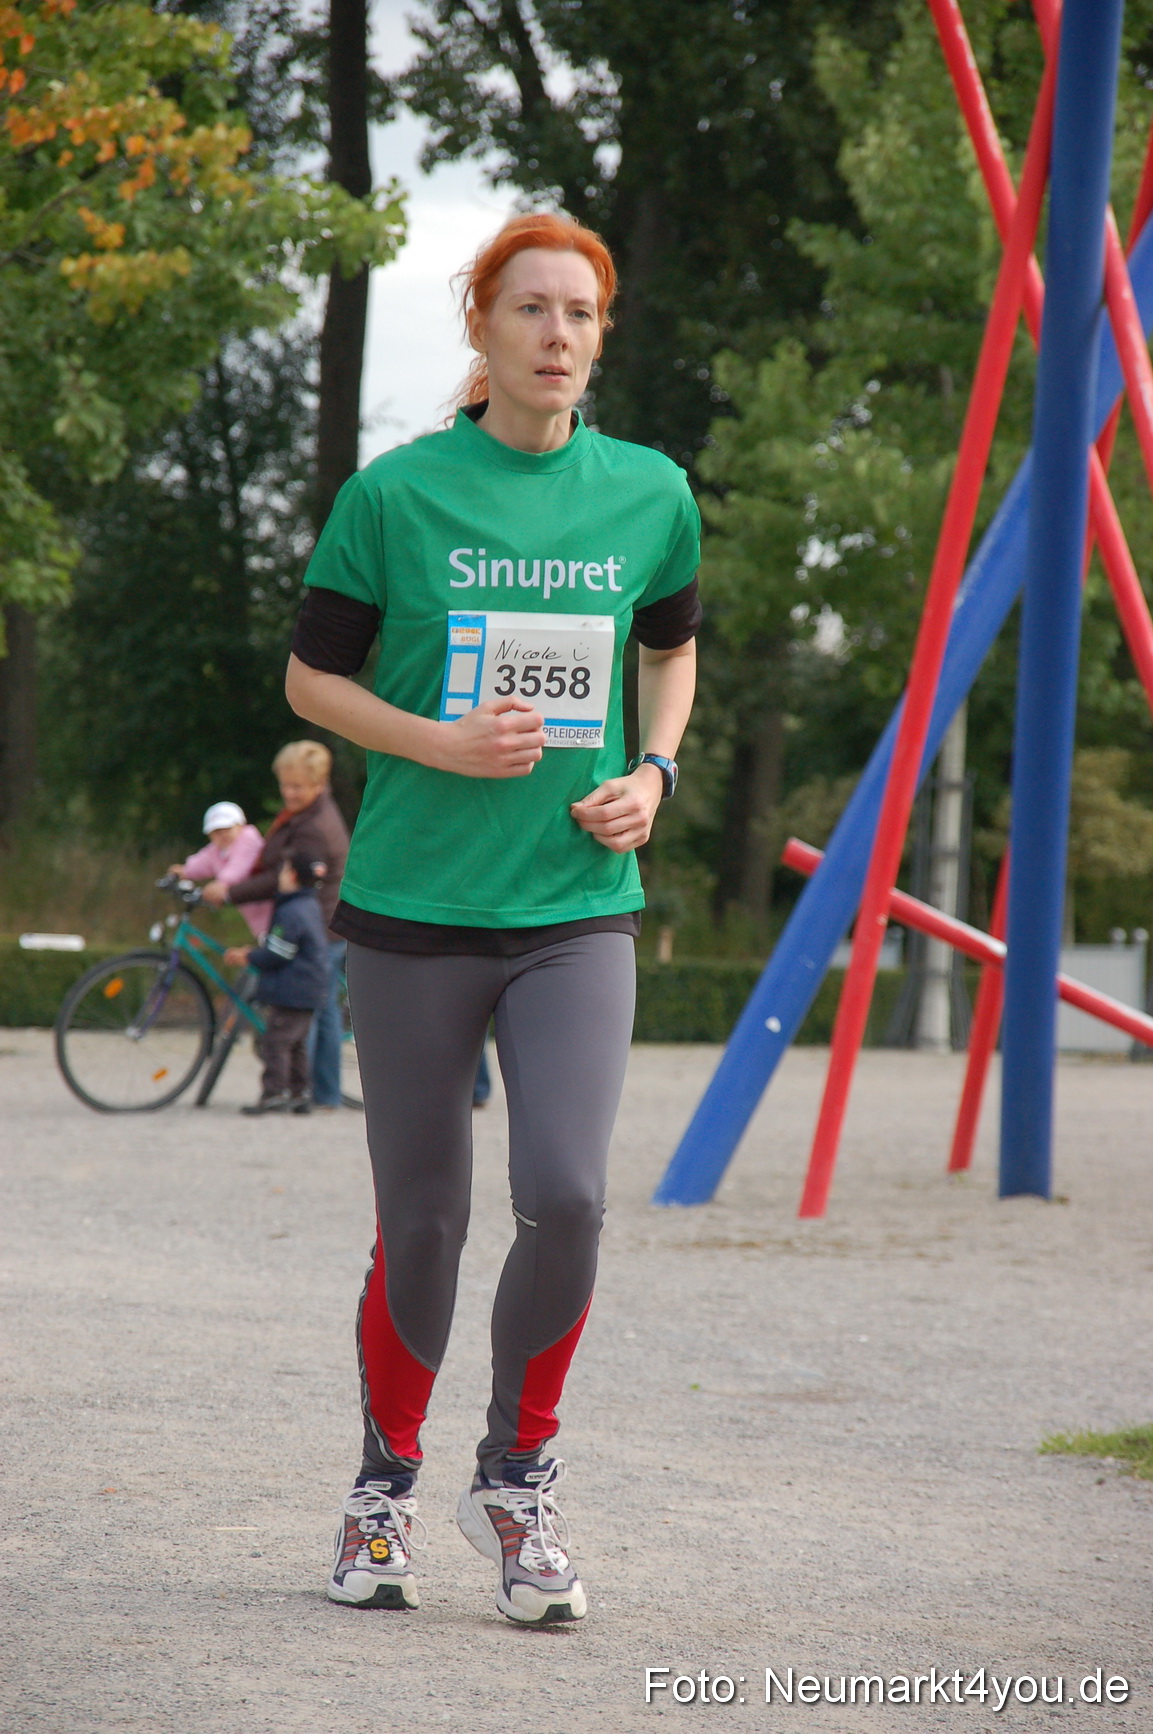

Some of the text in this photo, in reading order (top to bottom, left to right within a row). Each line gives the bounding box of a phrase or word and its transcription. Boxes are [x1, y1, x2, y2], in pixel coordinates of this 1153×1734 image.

[494, 638, 562, 661] Nicole
[494, 664, 591, 699] 3558
[542, 727, 600, 739] PFLEIDERER
[370, 1538, 389, 1559] S
